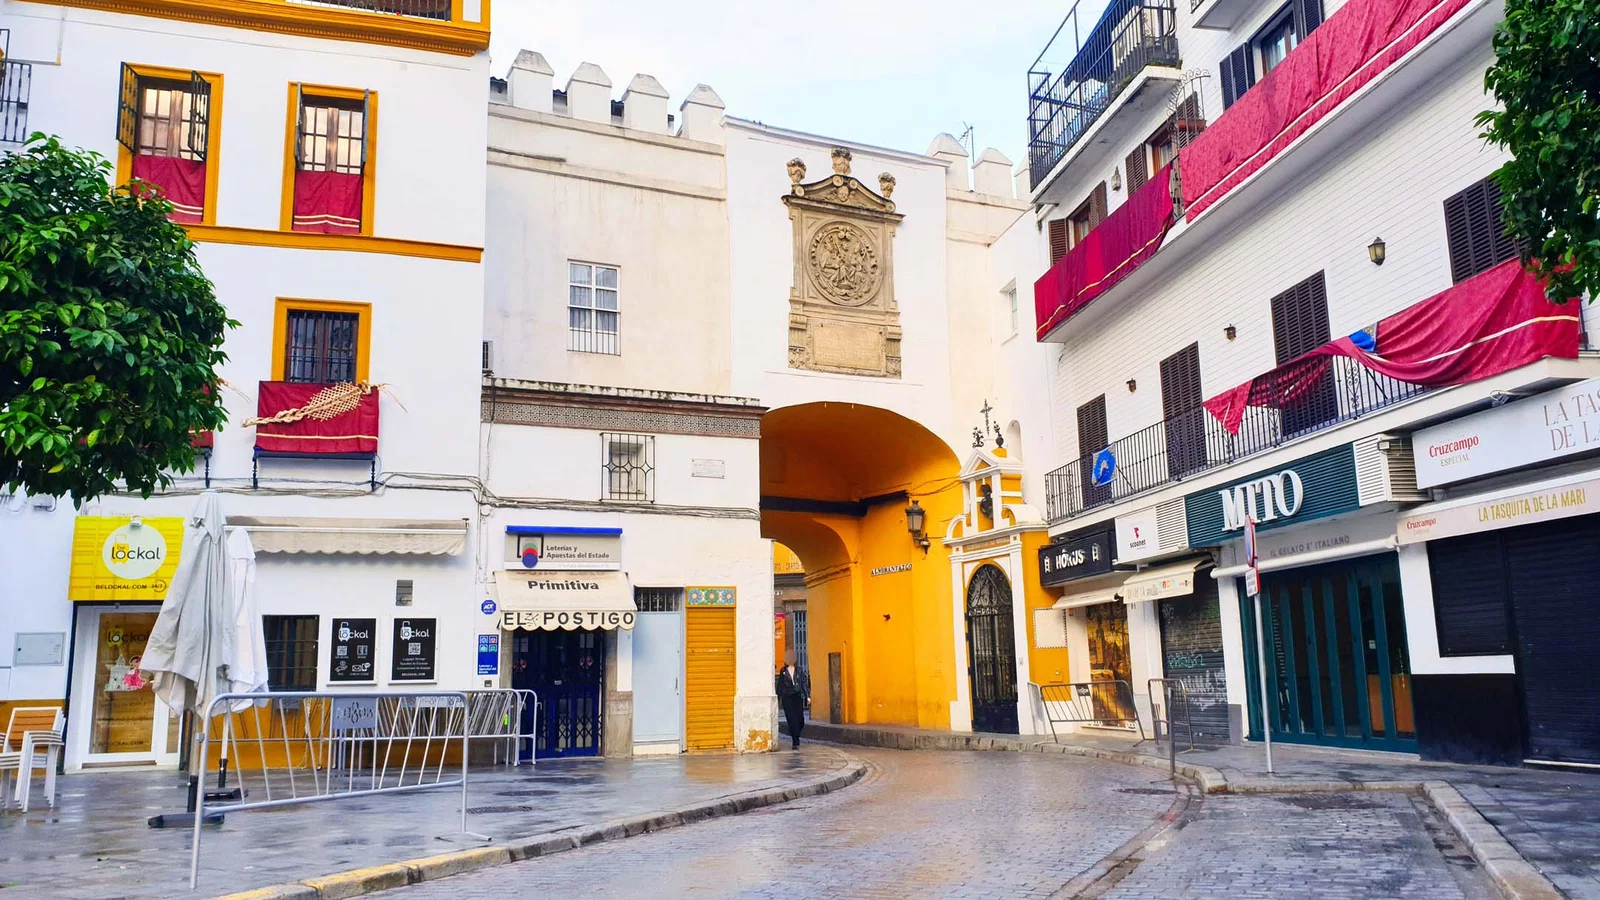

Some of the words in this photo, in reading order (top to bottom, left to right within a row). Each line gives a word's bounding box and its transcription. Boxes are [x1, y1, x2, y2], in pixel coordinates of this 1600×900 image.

[1543, 400, 1569, 427] LA
[1571, 389, 1600, 418] TA
[1550, 424, 1576, 451] DE
[1583, 420, 1600, 444] L
[1429, 435, 1480, 458] Cruzcampo
[1440, 453, 1471, 467] ESPECIAL
[1219, 470, 1303, 531] MITO
[1478, 507, 1489, 522] LA
[1490, 499, 1531, 521] TASQUITA
[1534, 495, 1545, 510] DE
[1546, 492, 1559, 509] LA
[1560, 487, 1587, 507] MARI
[1406, 517, 1437, 530] Cruzcampo
[111, 546, 161, 560] lockal
[1278, 545, 1304, 556] GELATO
[1315, 535, 1350, 549] ITALIANO
[528, 580, 600, 590] Primitiva
[503, 612, 527, 626] EL
[543, 612, 634, 625] POSTIGO
